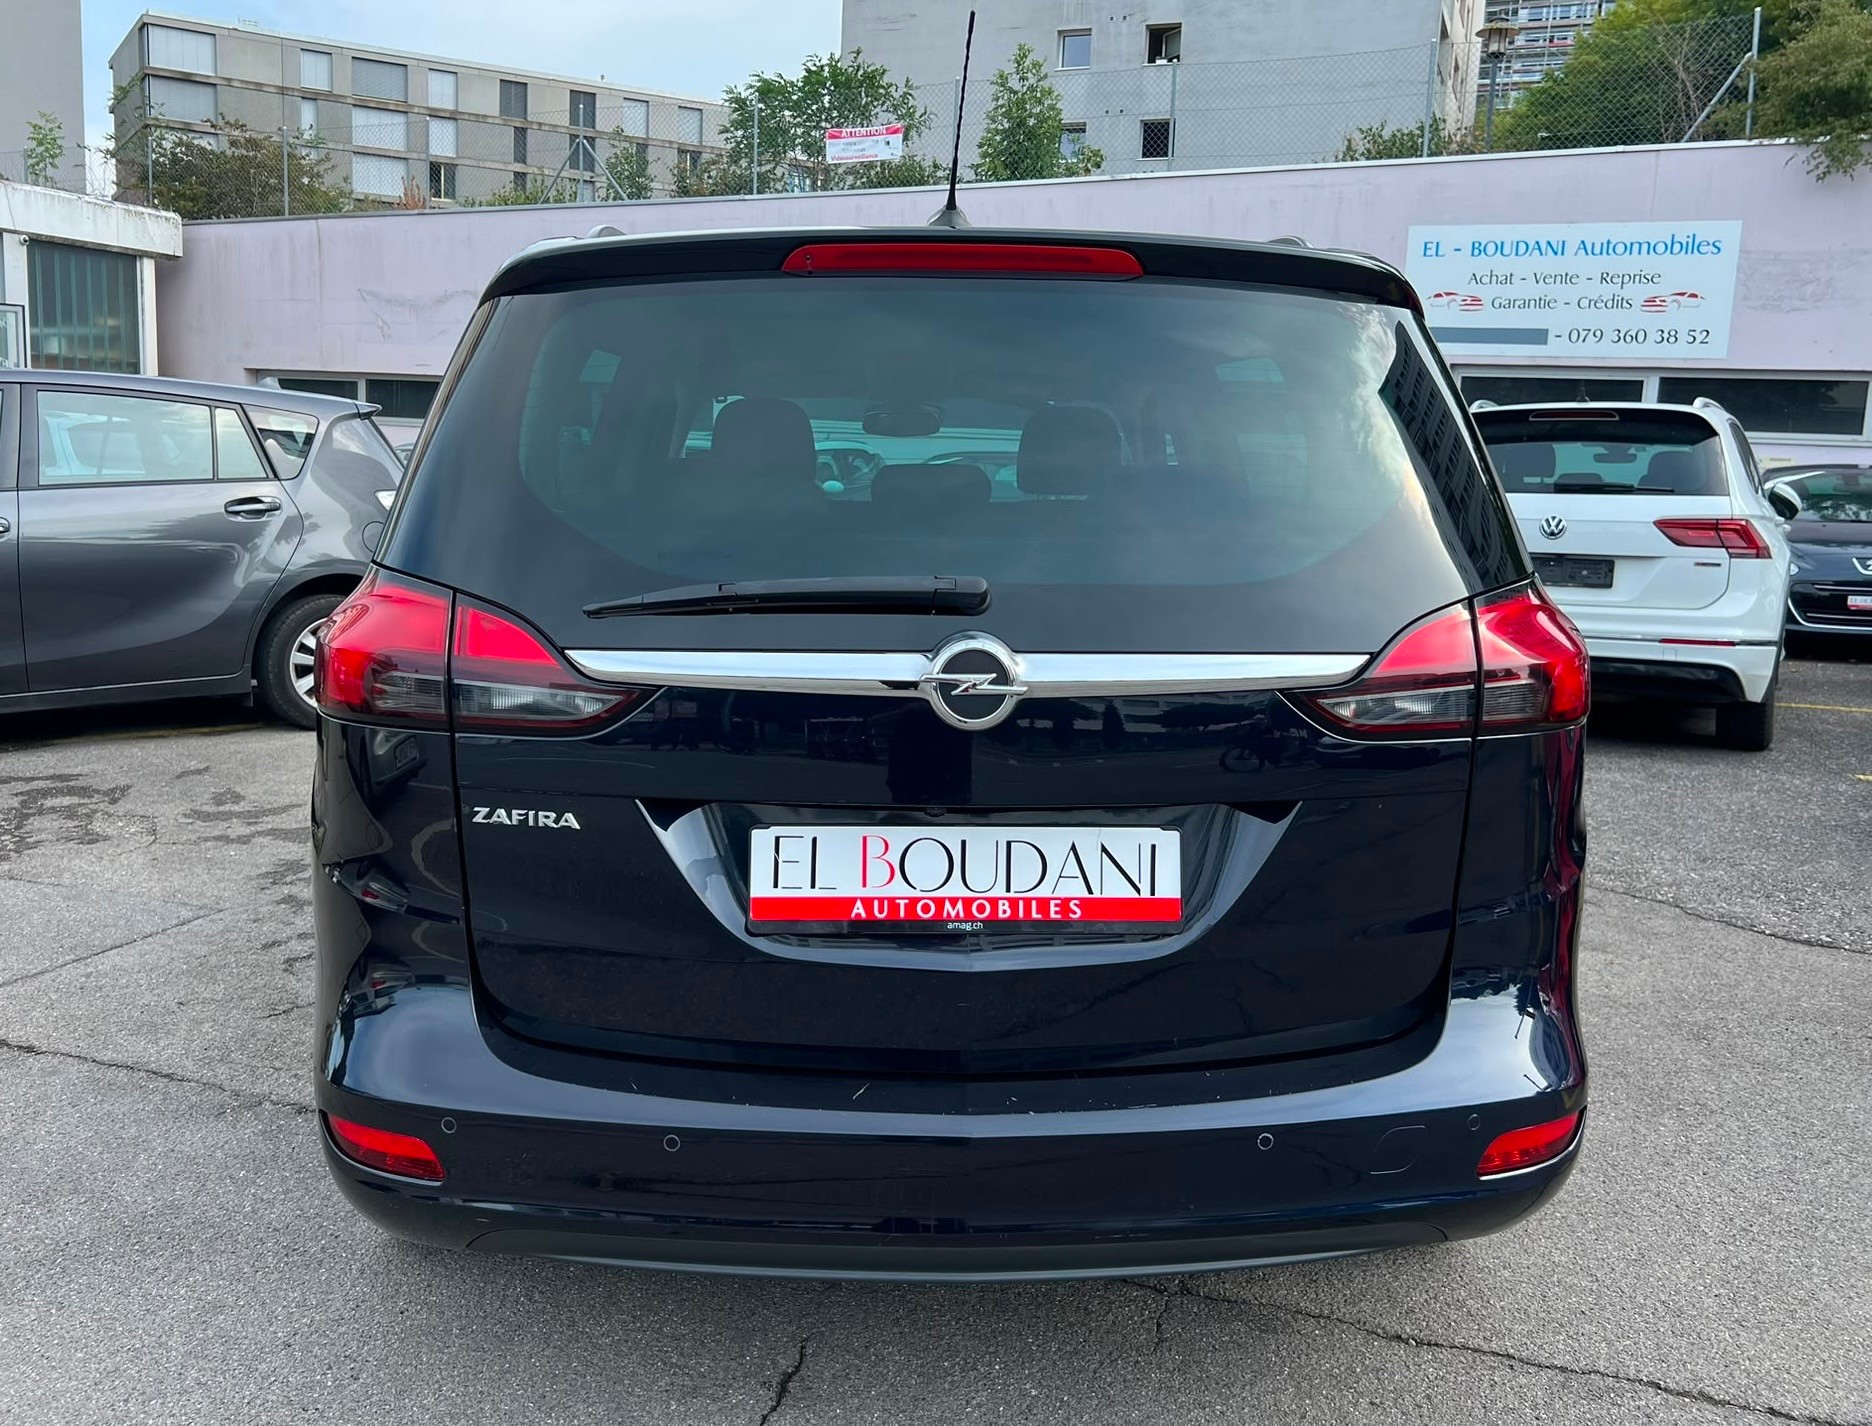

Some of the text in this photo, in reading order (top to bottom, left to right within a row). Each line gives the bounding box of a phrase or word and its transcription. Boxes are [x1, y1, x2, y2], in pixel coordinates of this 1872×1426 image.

[841, 126, 887, 138] ATTENTION
[1422, 241, 1446, 257] EL
[1470, 239, 1566, 257] BOUDANI
[1573, 233, 1723, 256] Automobiles
[1467, 269, 1515, 285] Achat
[1533, 271, 1580, 285] Vente
[1599, 269, 1662, 289] Reprise
[1491, 295, 1558, 310] Garantie
[1576, 294, 1633, 310] Crédits
[1567, 328, 1604, 344] 079
[1610, 328, 1648, 345] 360
[1654, 328, 1679, 345] 38
[1685, 328, 1711, 345] 52
[472, 806, 581, 829] ZAFIRA
[772, 834, 1157, 897] EL BOUDANI
[850, 898, 1083, 919] AUTOMOBILES
[946, 921, 984, 931] amag.ch
